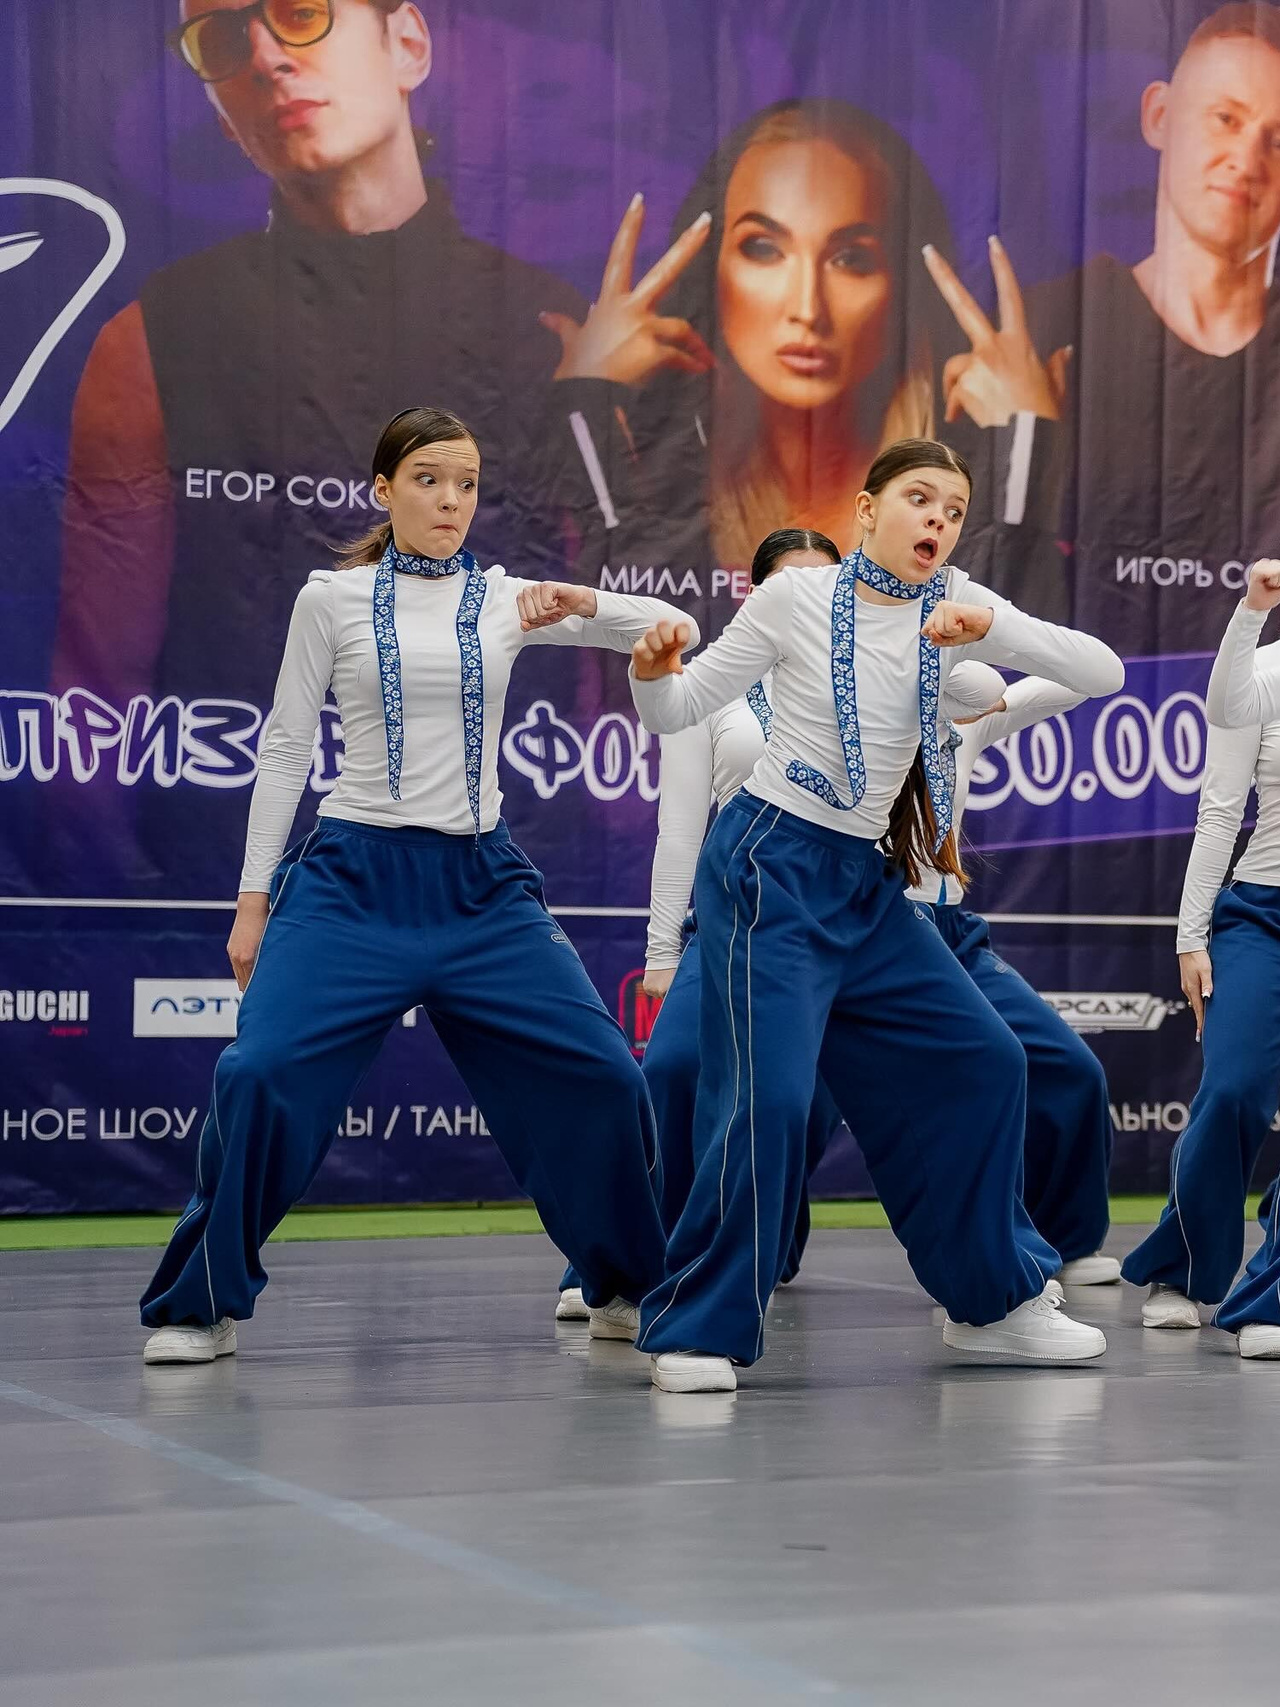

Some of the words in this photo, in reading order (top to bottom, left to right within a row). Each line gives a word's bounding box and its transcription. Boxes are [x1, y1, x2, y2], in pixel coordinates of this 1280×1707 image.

[186, 467, 275, 502] ЕГОР
[600, 564, 703, 597] МИЛА
[1116, 555, 1214, 588] ИГОРЬ
[3, 1107, 87, 1141] НОЕ
[99, 1106, 198, 1140] ШОУ
